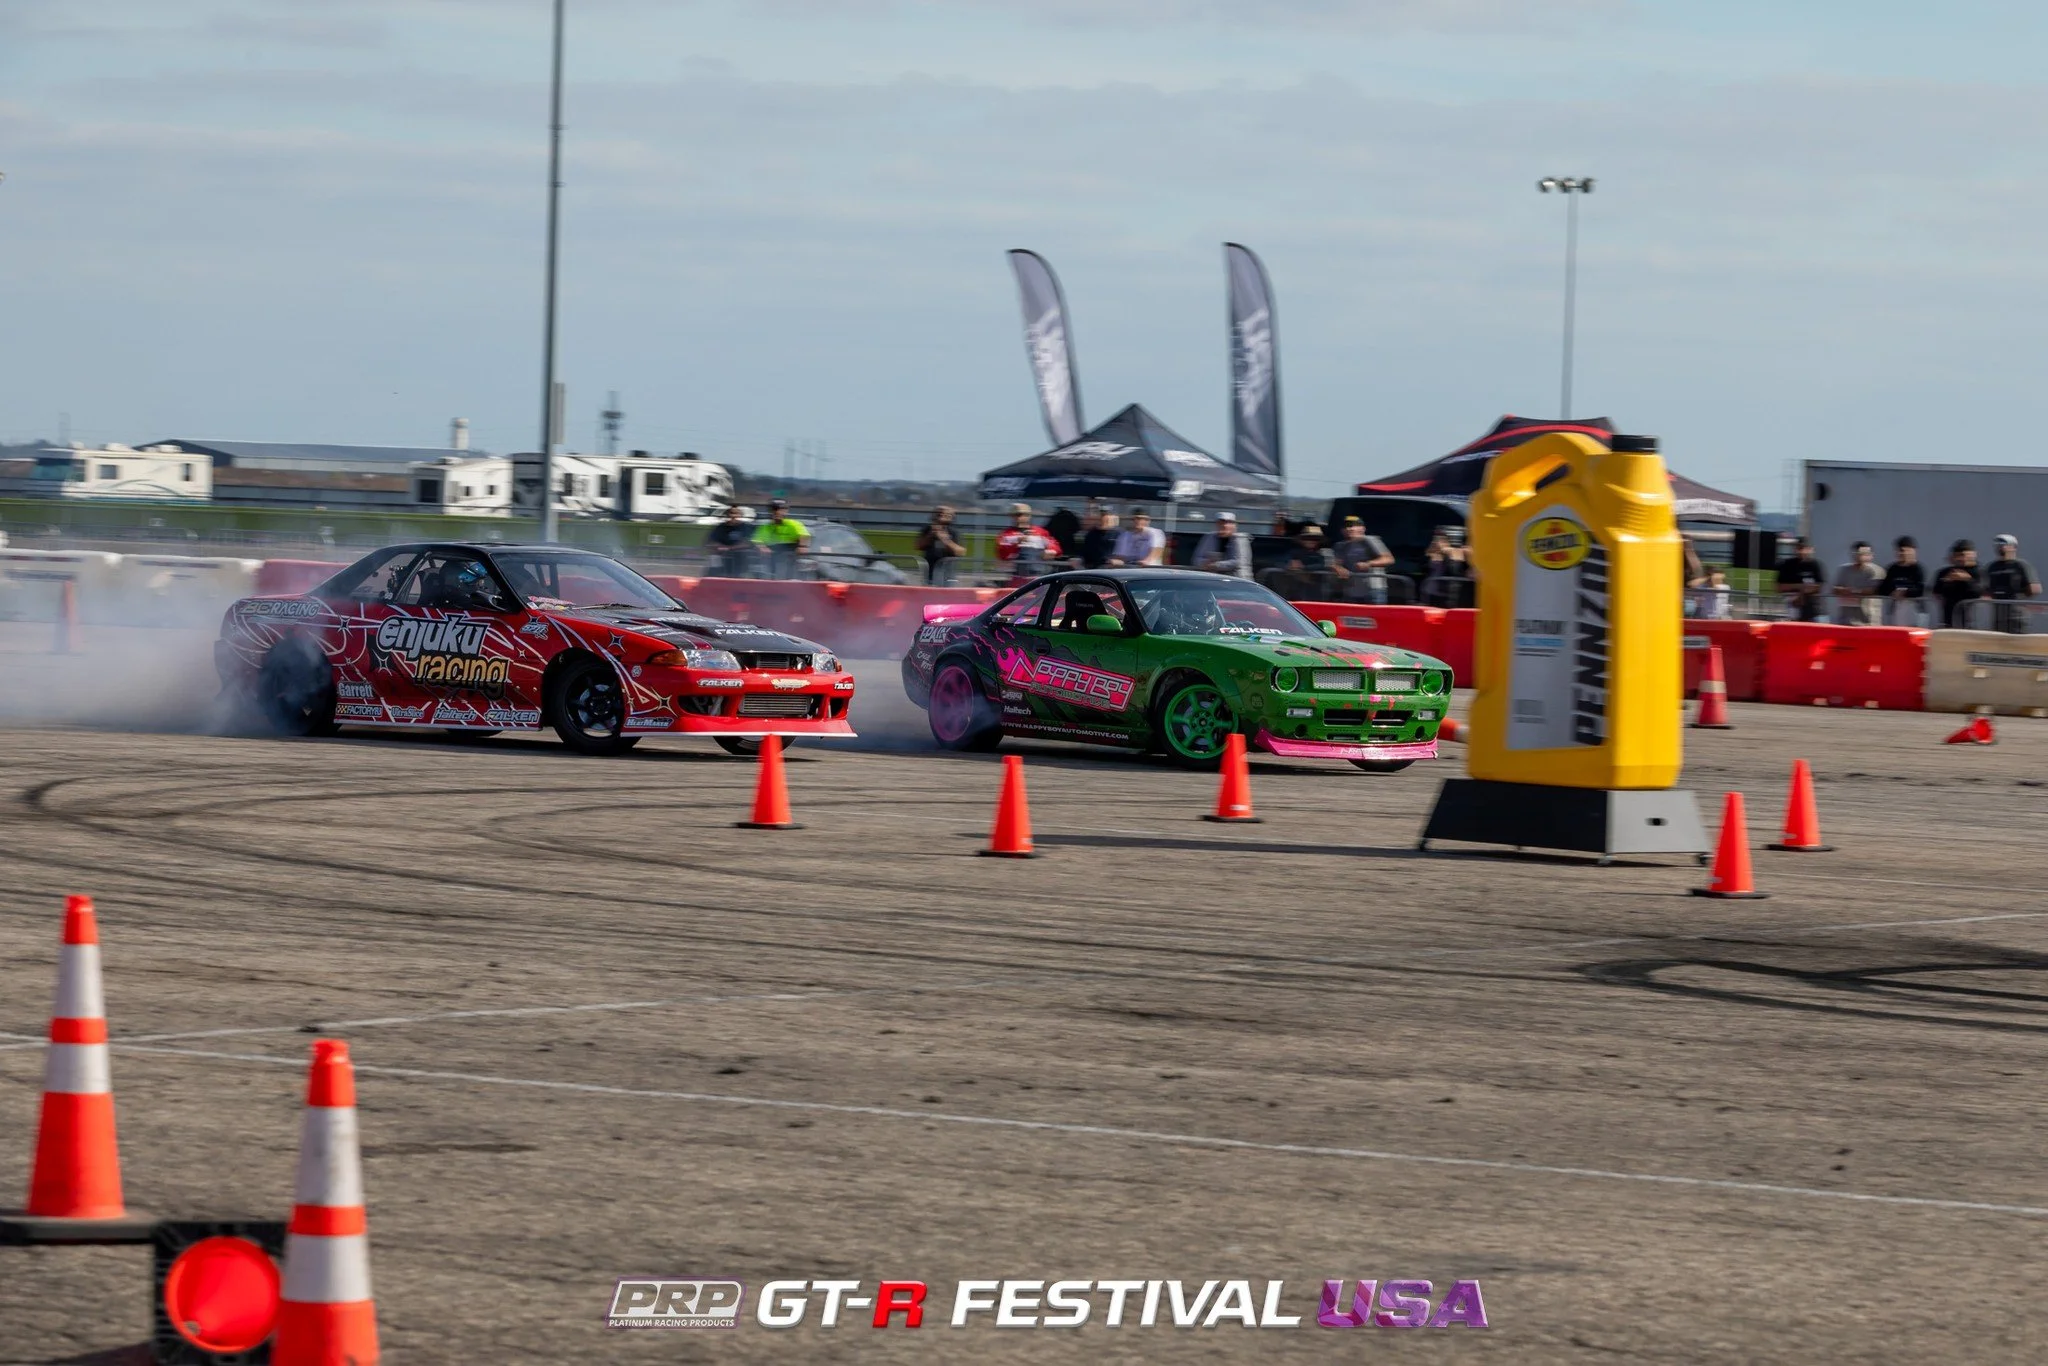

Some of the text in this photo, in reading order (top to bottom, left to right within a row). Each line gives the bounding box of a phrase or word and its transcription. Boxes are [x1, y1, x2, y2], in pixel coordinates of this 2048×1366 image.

[377, 614, 486, 659] enjuku
[714, 628, 782, 638] FALKEN
[1219, 627, 1283, 636] FALKEN
[416, 654, 507, 696] racing
[699, 679, 744, 688] FALKEN
[338, 682, 374, 698] Garrett
[435, 708, 477, 720] Haltech
[485, 709, 539, 722] FALKEN
[1003, 705, 1032, 715] Haltech
